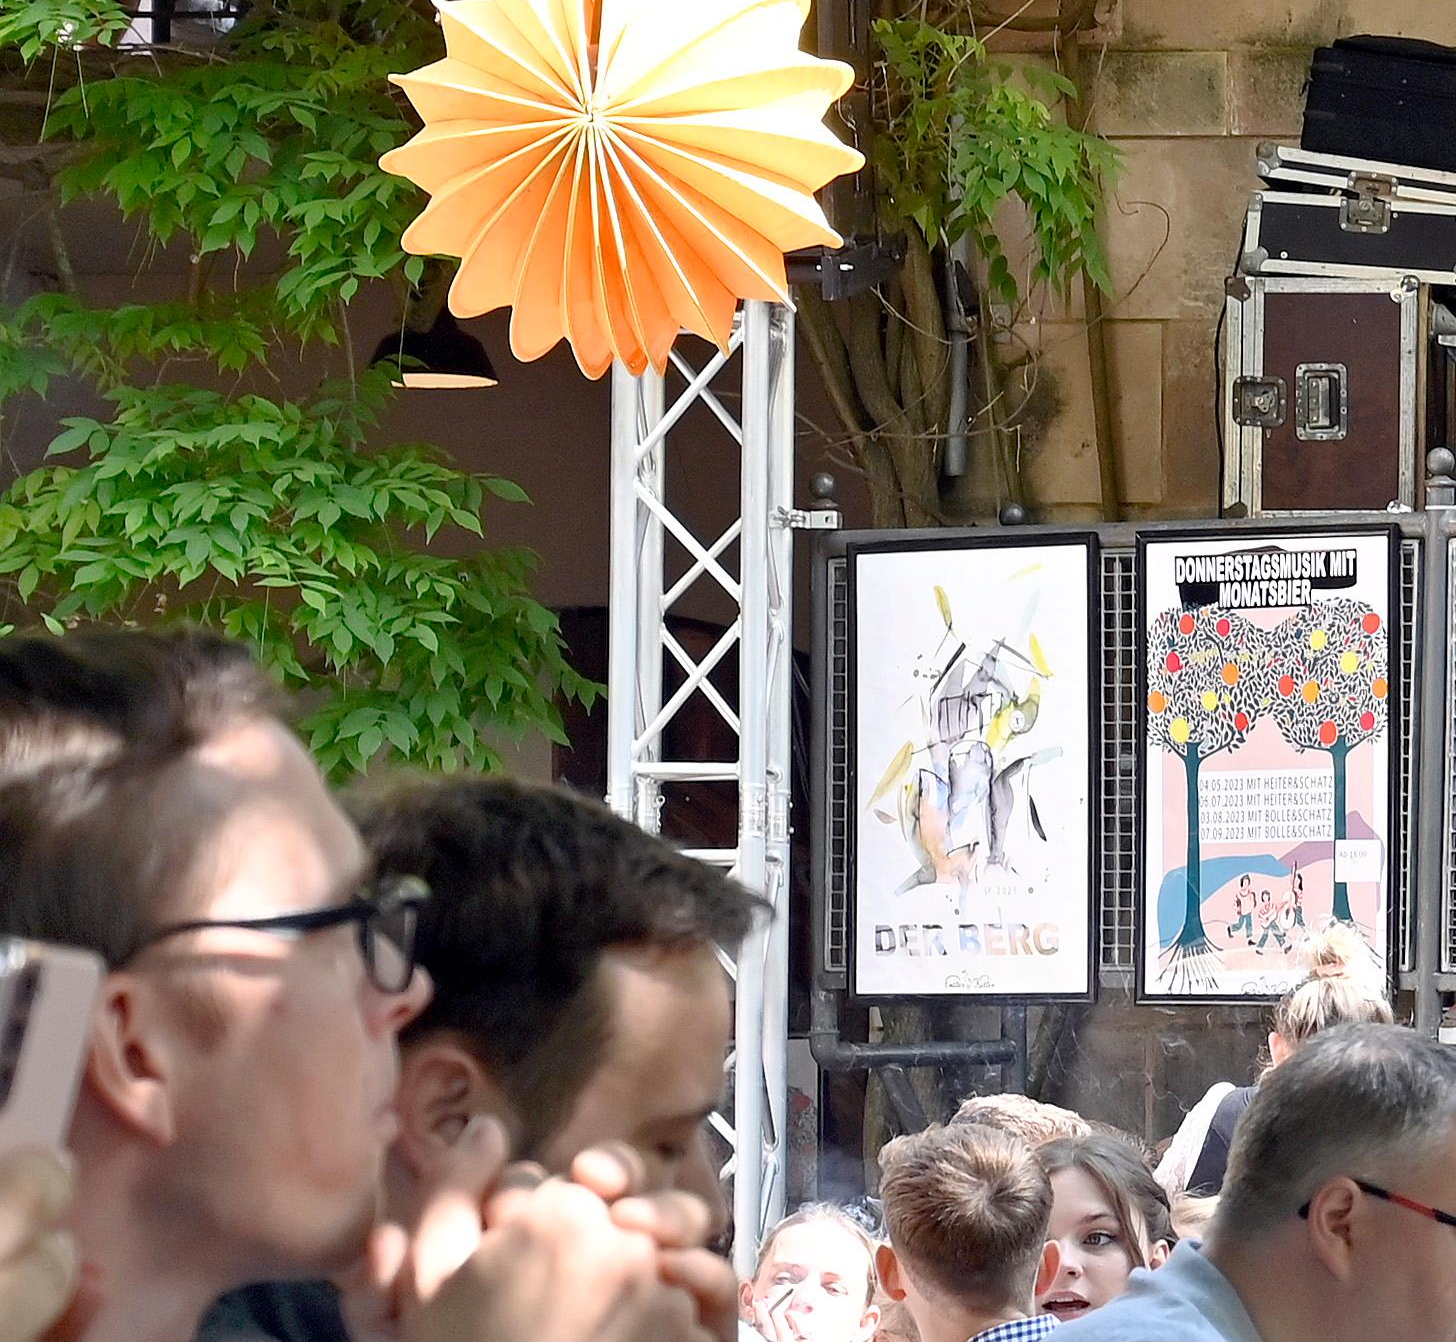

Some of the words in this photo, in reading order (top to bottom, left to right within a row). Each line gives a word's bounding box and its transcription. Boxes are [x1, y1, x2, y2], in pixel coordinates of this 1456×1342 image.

[1175, 552, 1327, 584] DONNERSTAGSMUSIK
[1329, 550, 1356, 578] MIT
[1218, 579, 1312, 609] MONATSBIER
[1199, 778, 1244, 792] 04.05.2023
[1246, 777, 1261, 790] MIT
[1263, 775, 1333, 789] HEITER&SCHATZ
[1246, 793, 1261, 806] MIT
[1263, 791, 1333, 805] HEITER&SCHATZ
[1200, 811, 1244, 825] 03.08.2023
[1248, 810, 1262, 823] MIT
[1264, 808, 1332, 822] BOLLE&SCHATZ
[1200, 827, 1244, 841] 07.09.2023
[1248, 826, 1262, 839] MIT
[1264, 824, 1332, 838] BOLLE&SCHATZ
[874, 923, 948, 957] DER
[957, 922, 1060, 957] BERG
